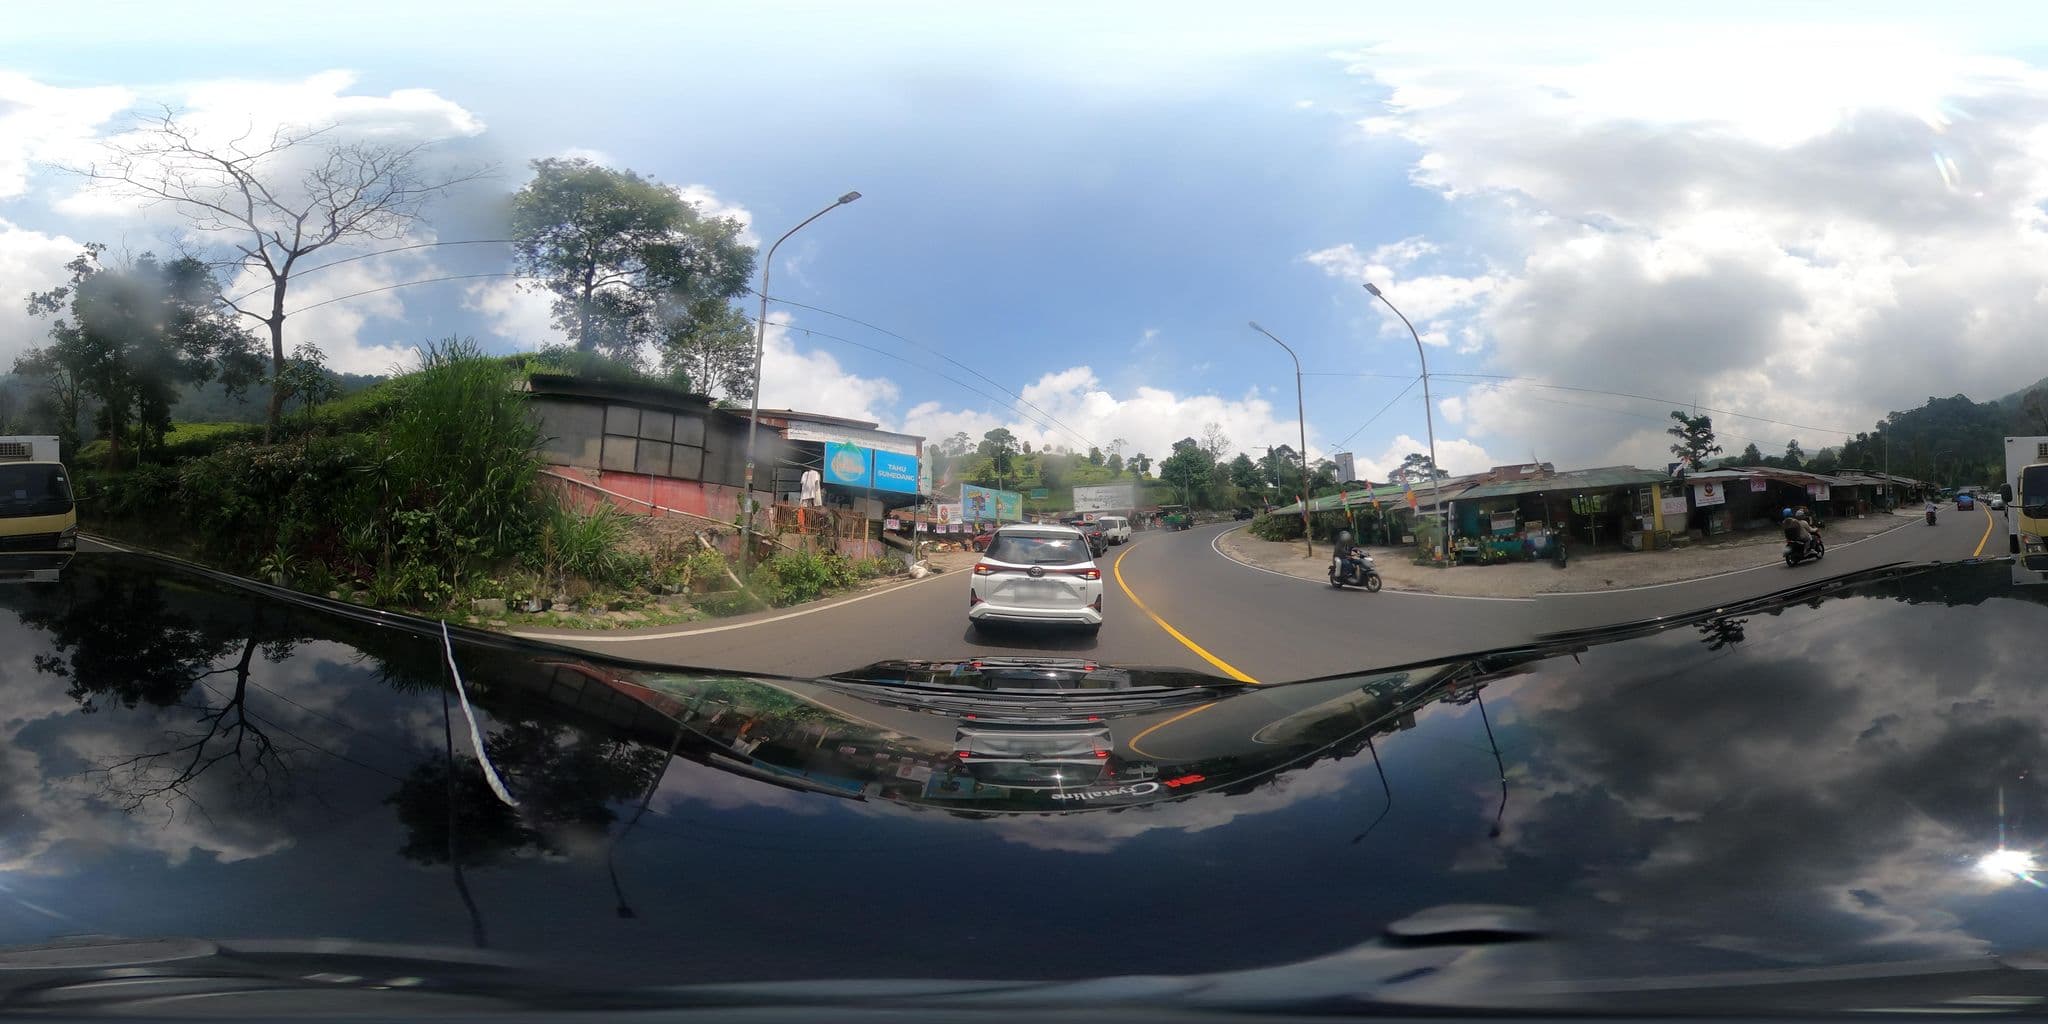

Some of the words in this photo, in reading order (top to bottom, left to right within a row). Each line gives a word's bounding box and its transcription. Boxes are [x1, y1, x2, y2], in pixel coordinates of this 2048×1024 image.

[887, 464, 907, 472] TAHU
[878, 471, 915, 481] SUMEDANG
[1051, 782, 1159, 802] Crystalline
